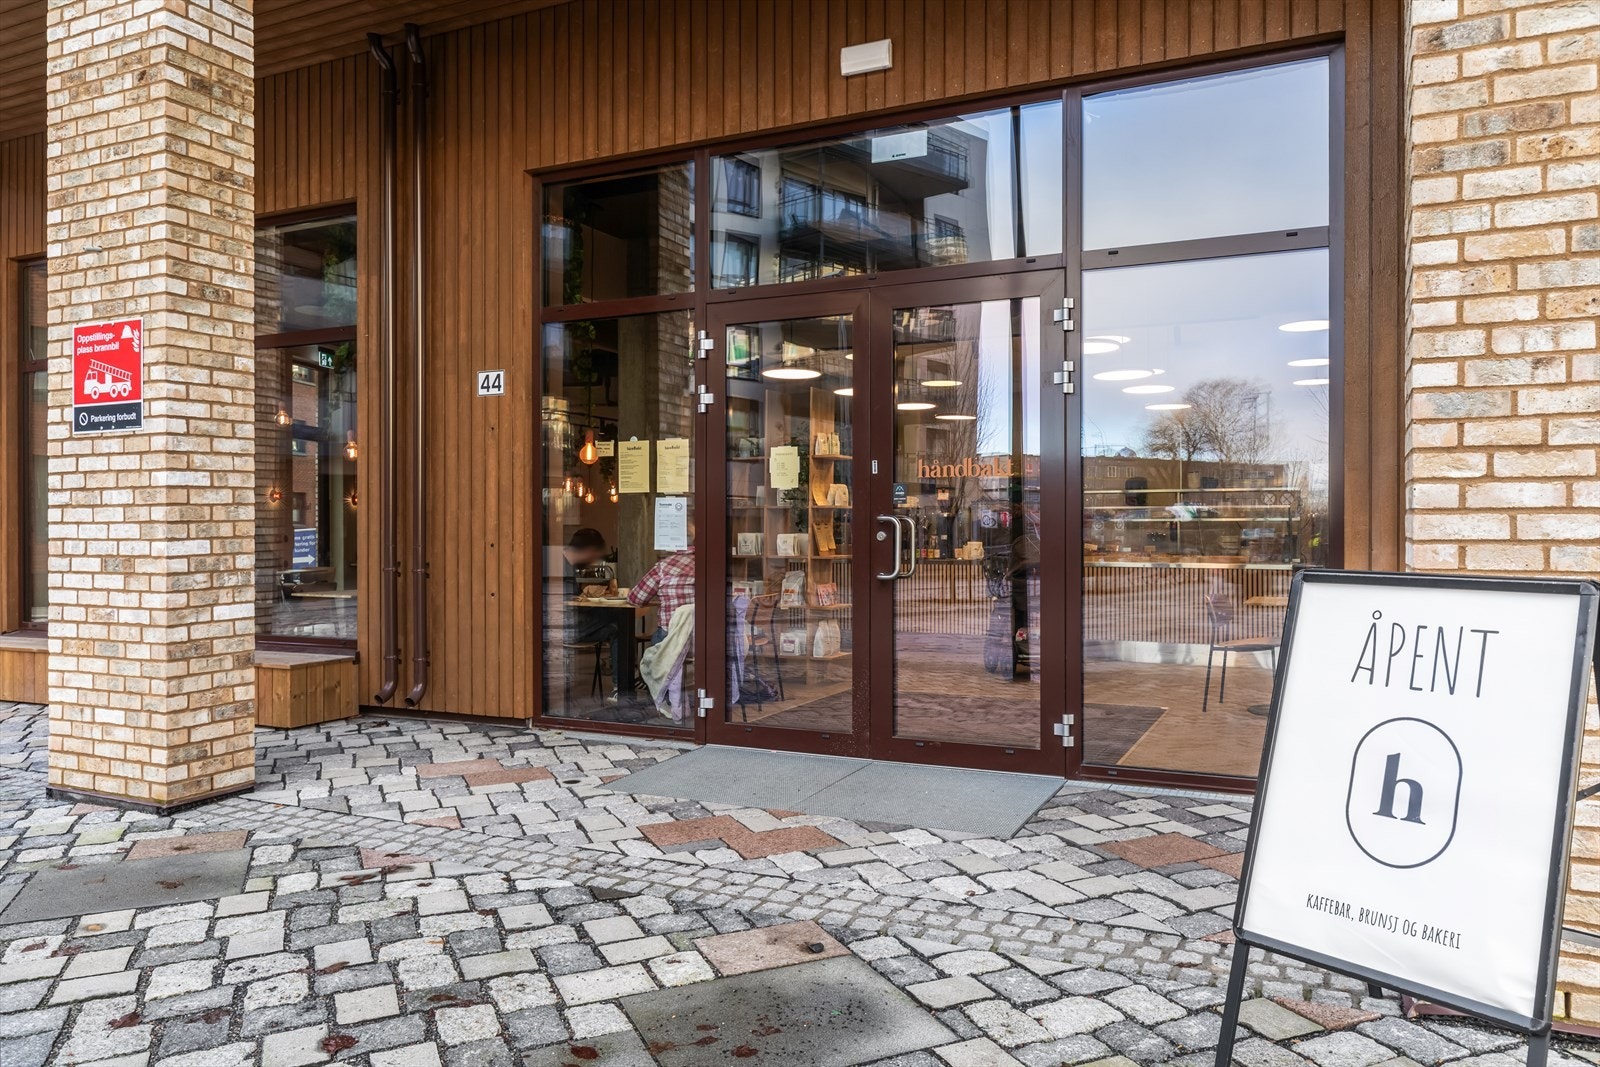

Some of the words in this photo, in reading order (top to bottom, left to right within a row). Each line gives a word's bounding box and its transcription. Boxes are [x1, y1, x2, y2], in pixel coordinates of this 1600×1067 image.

[77, 332, 115, 344] Oppstillings-
[77, 347, 93, 355] plass
[94, 342, 119, 352] brannbil
[480, 373, 502, 392] 44
[91, 414, 116, 423] Parkering
[117, 412, 136, 420] forbudt
[917, 457, 1015, 478] håndbakt
[1351, 610, 1500, 698] ÅPENT
[1373, 753, 1426, 825] h
[1306, 893, 1354, 921] KAFFEBAR,
[1358, 907, 1400, 934] BRUNSJ
[1402, 919, 1418, 938] OG
[1421, 924, 1461, 949] BAKERI
